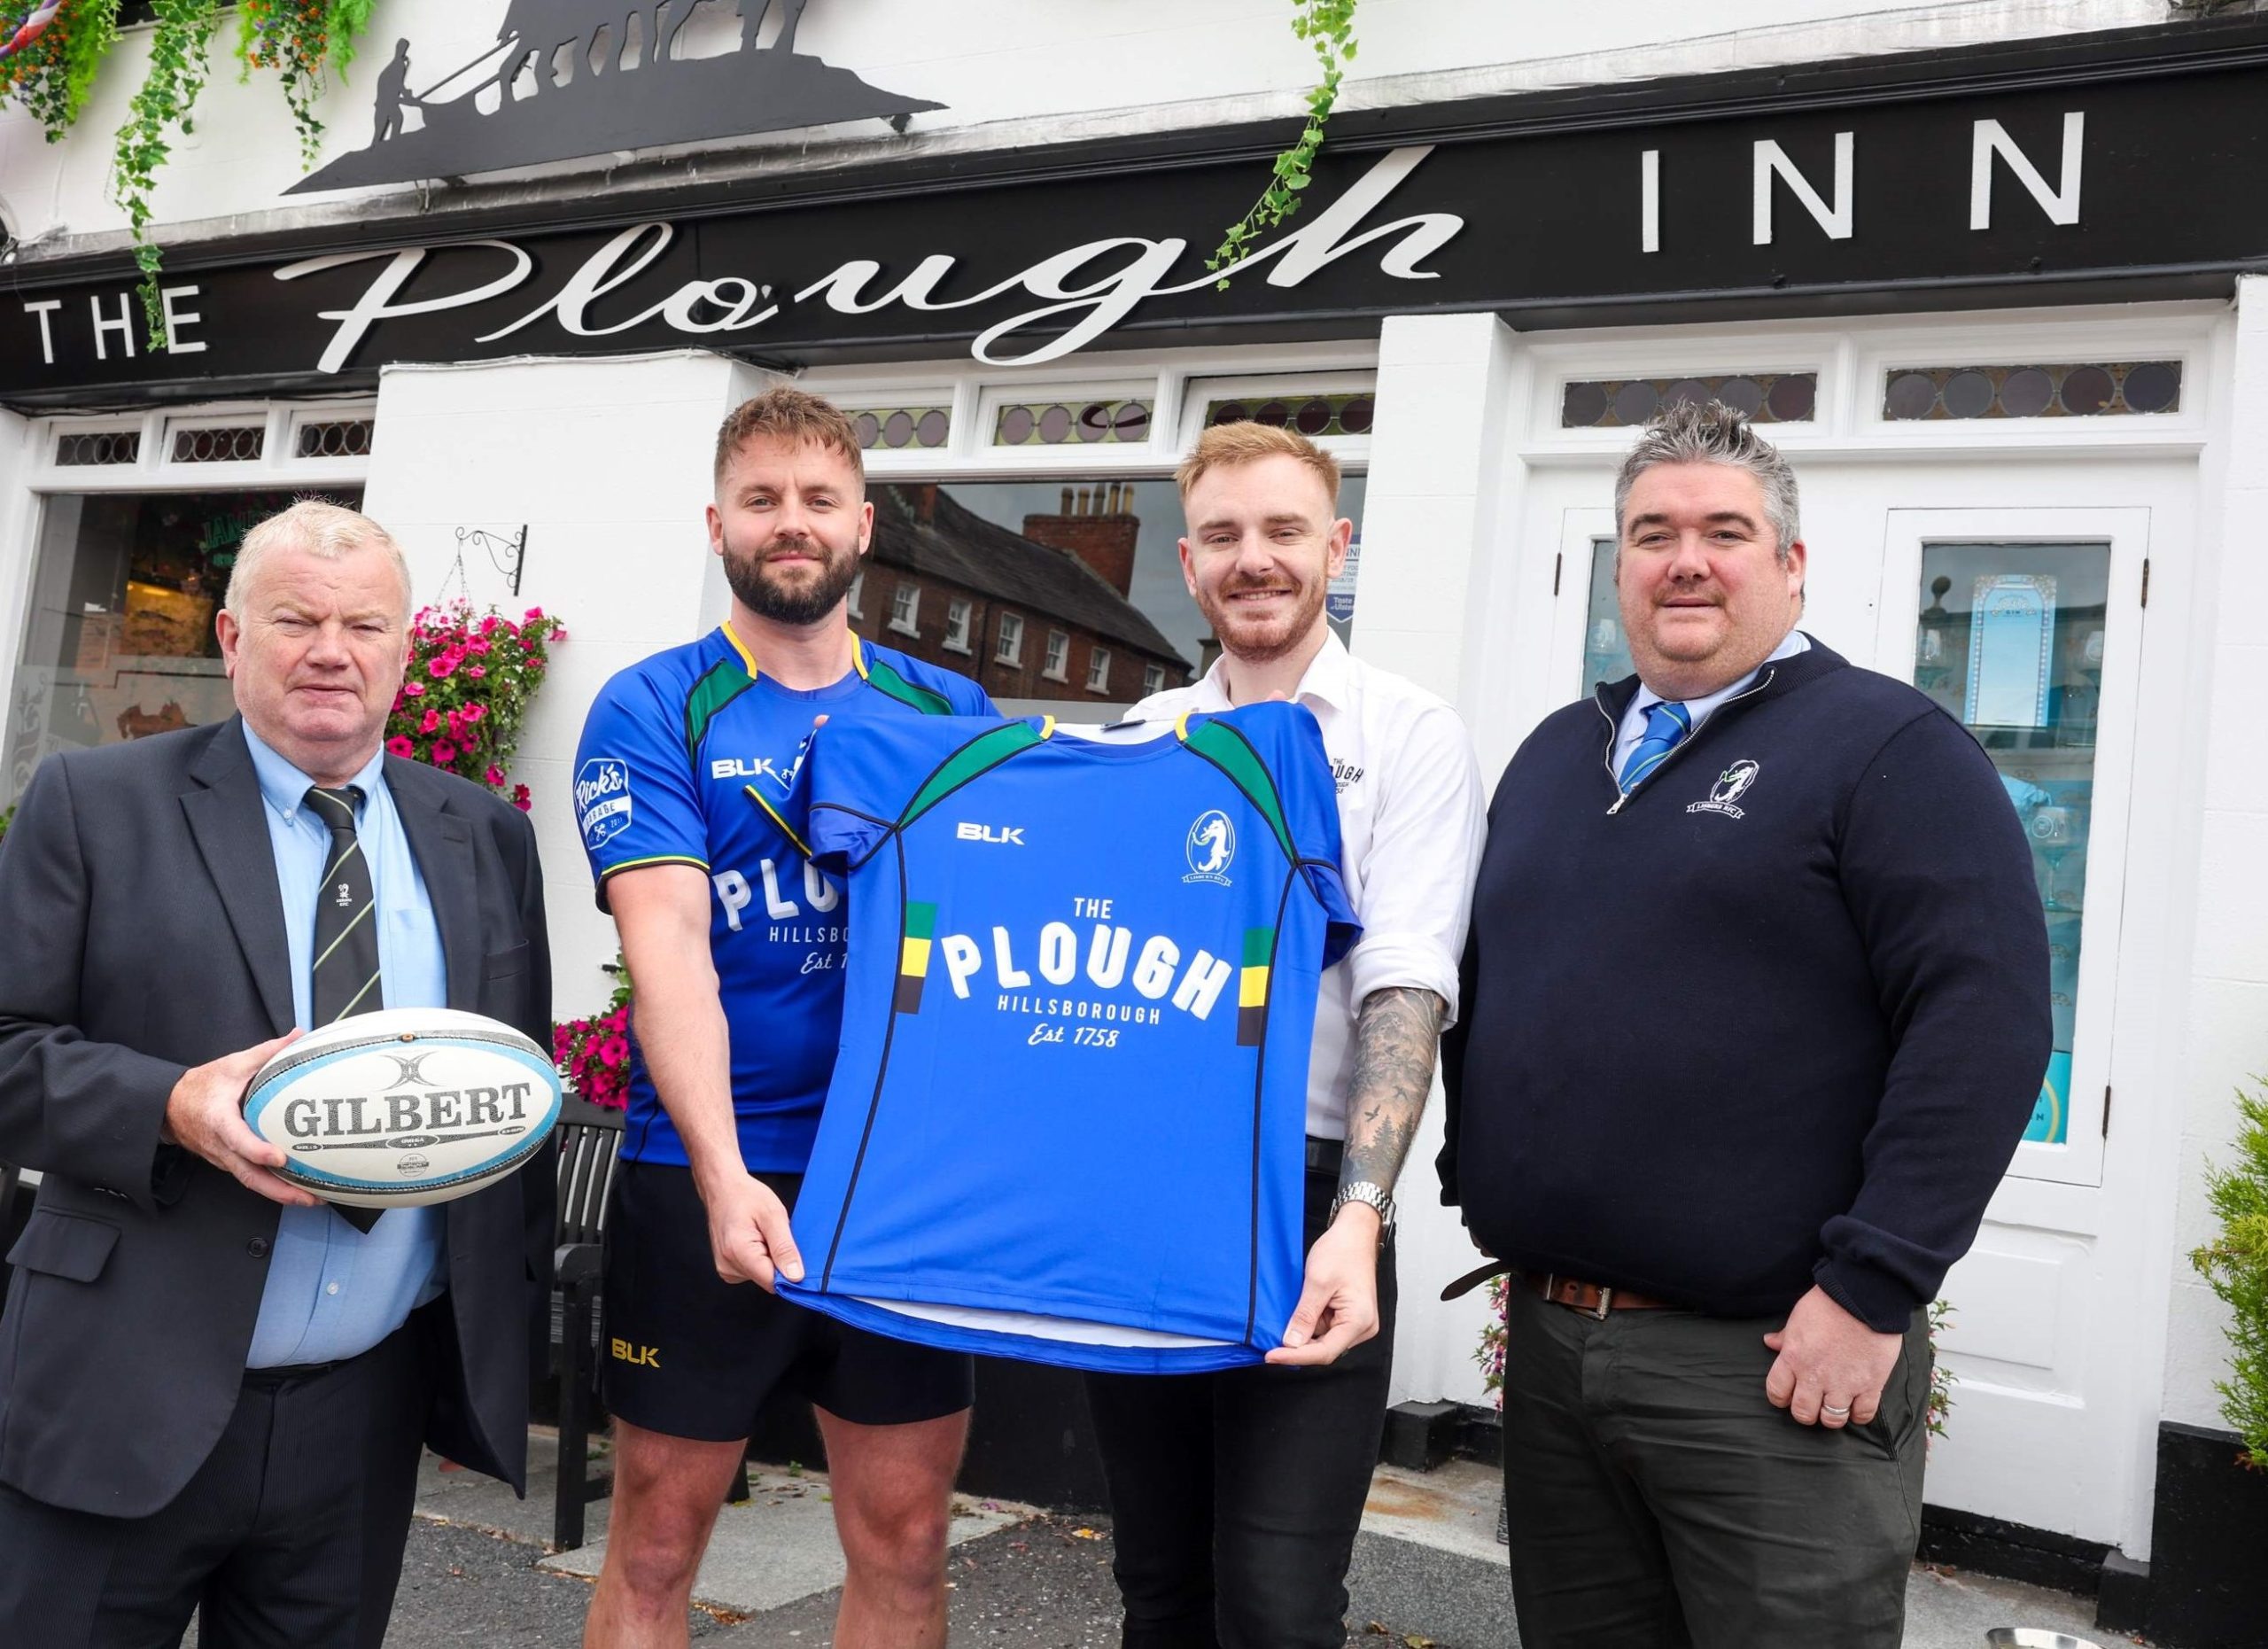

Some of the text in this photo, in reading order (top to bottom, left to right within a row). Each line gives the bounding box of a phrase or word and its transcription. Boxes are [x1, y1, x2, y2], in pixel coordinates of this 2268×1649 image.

[24, 112, 2085, 374] THE Plough INN
[711, 758, 776, 779] BLK
[1329, 765, 1363, 782] UGH
[957, 822, 1025, 845] BLK
[712, 858, 839, 931] PLO
[1074, 898, 1113, 920] THE
[801, 952, 832, 974] Est
[941, 922, 1232, 1021] PLOUGH
[998, 995, 1161, 1025] HILLSBOROUGH
[1028, 1023, 1120, 1047] Est 1758
[284, 1082, 531, 1138] GILBERT
[611, 1338, 661, 1368] BLK
